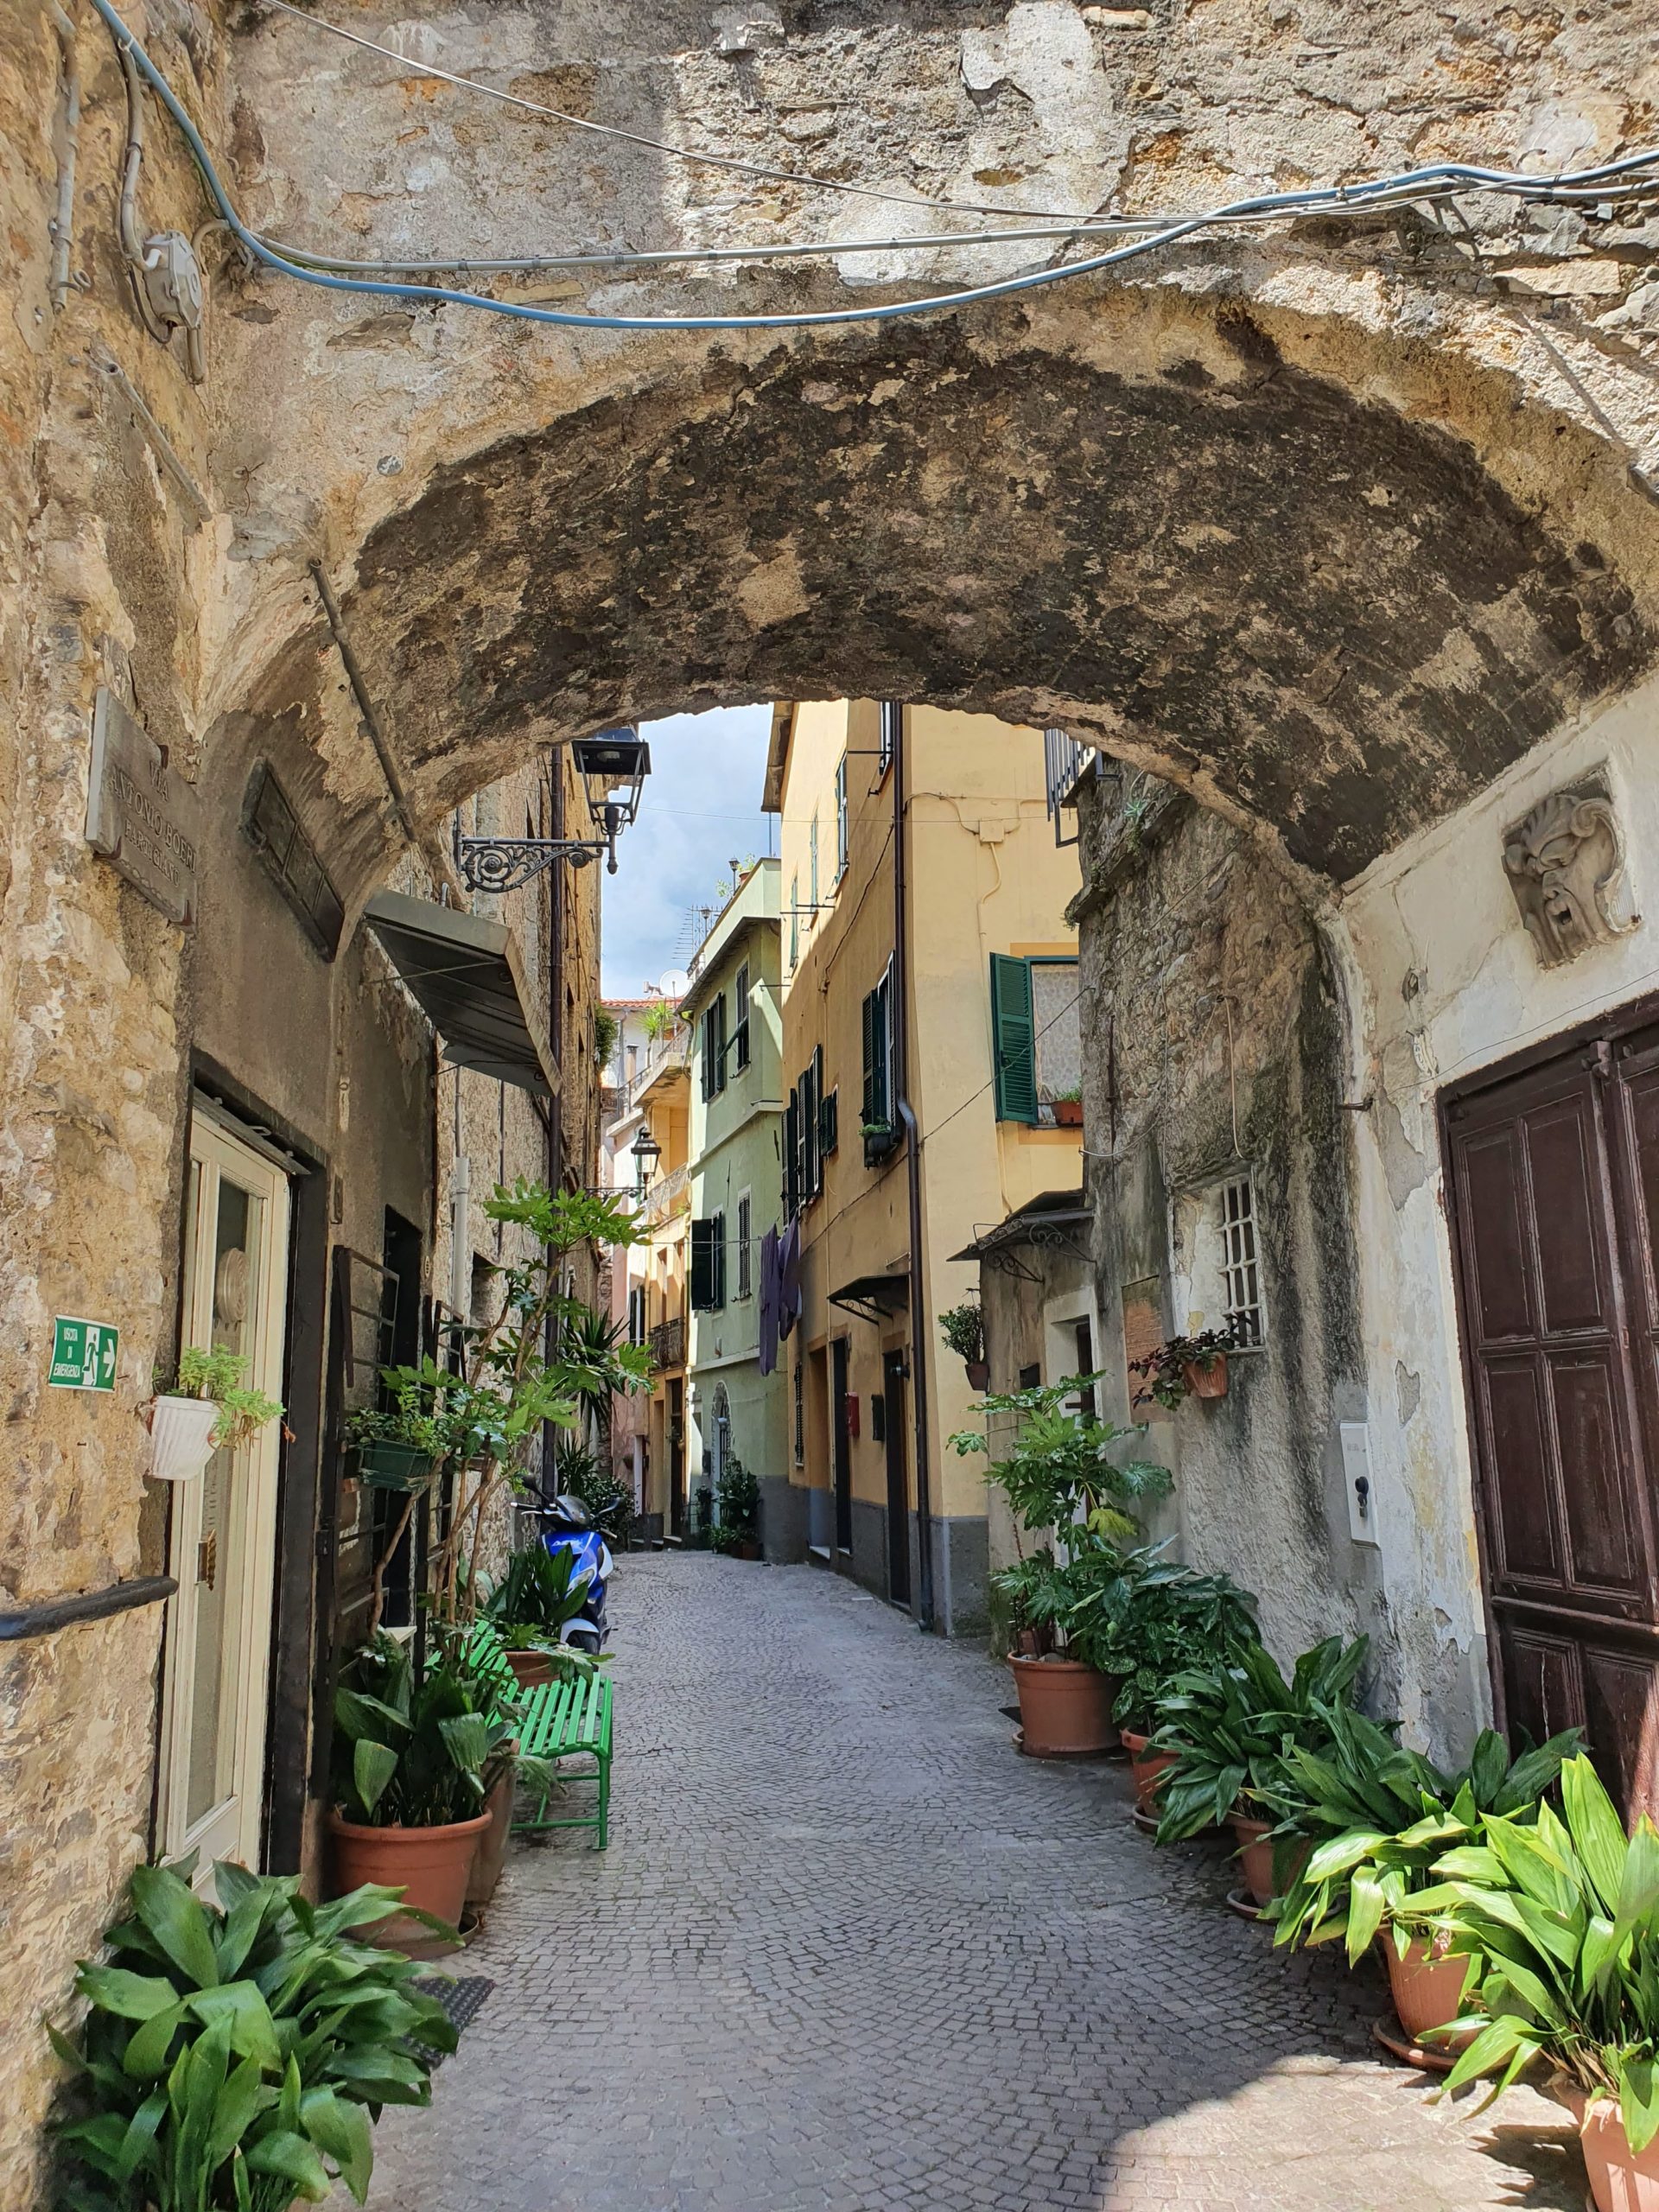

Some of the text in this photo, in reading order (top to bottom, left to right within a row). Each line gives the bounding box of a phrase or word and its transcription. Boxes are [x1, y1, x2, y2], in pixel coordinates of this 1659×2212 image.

[149, 760, 169, 802] VIA
[107, 765, 197, 874] ANTONIO BOERI
[124, 817, 180, 887] PARTIGIANO
[64, 1327, 78, 1341] USCITA
[67, 1346, 73, 1359] DI
